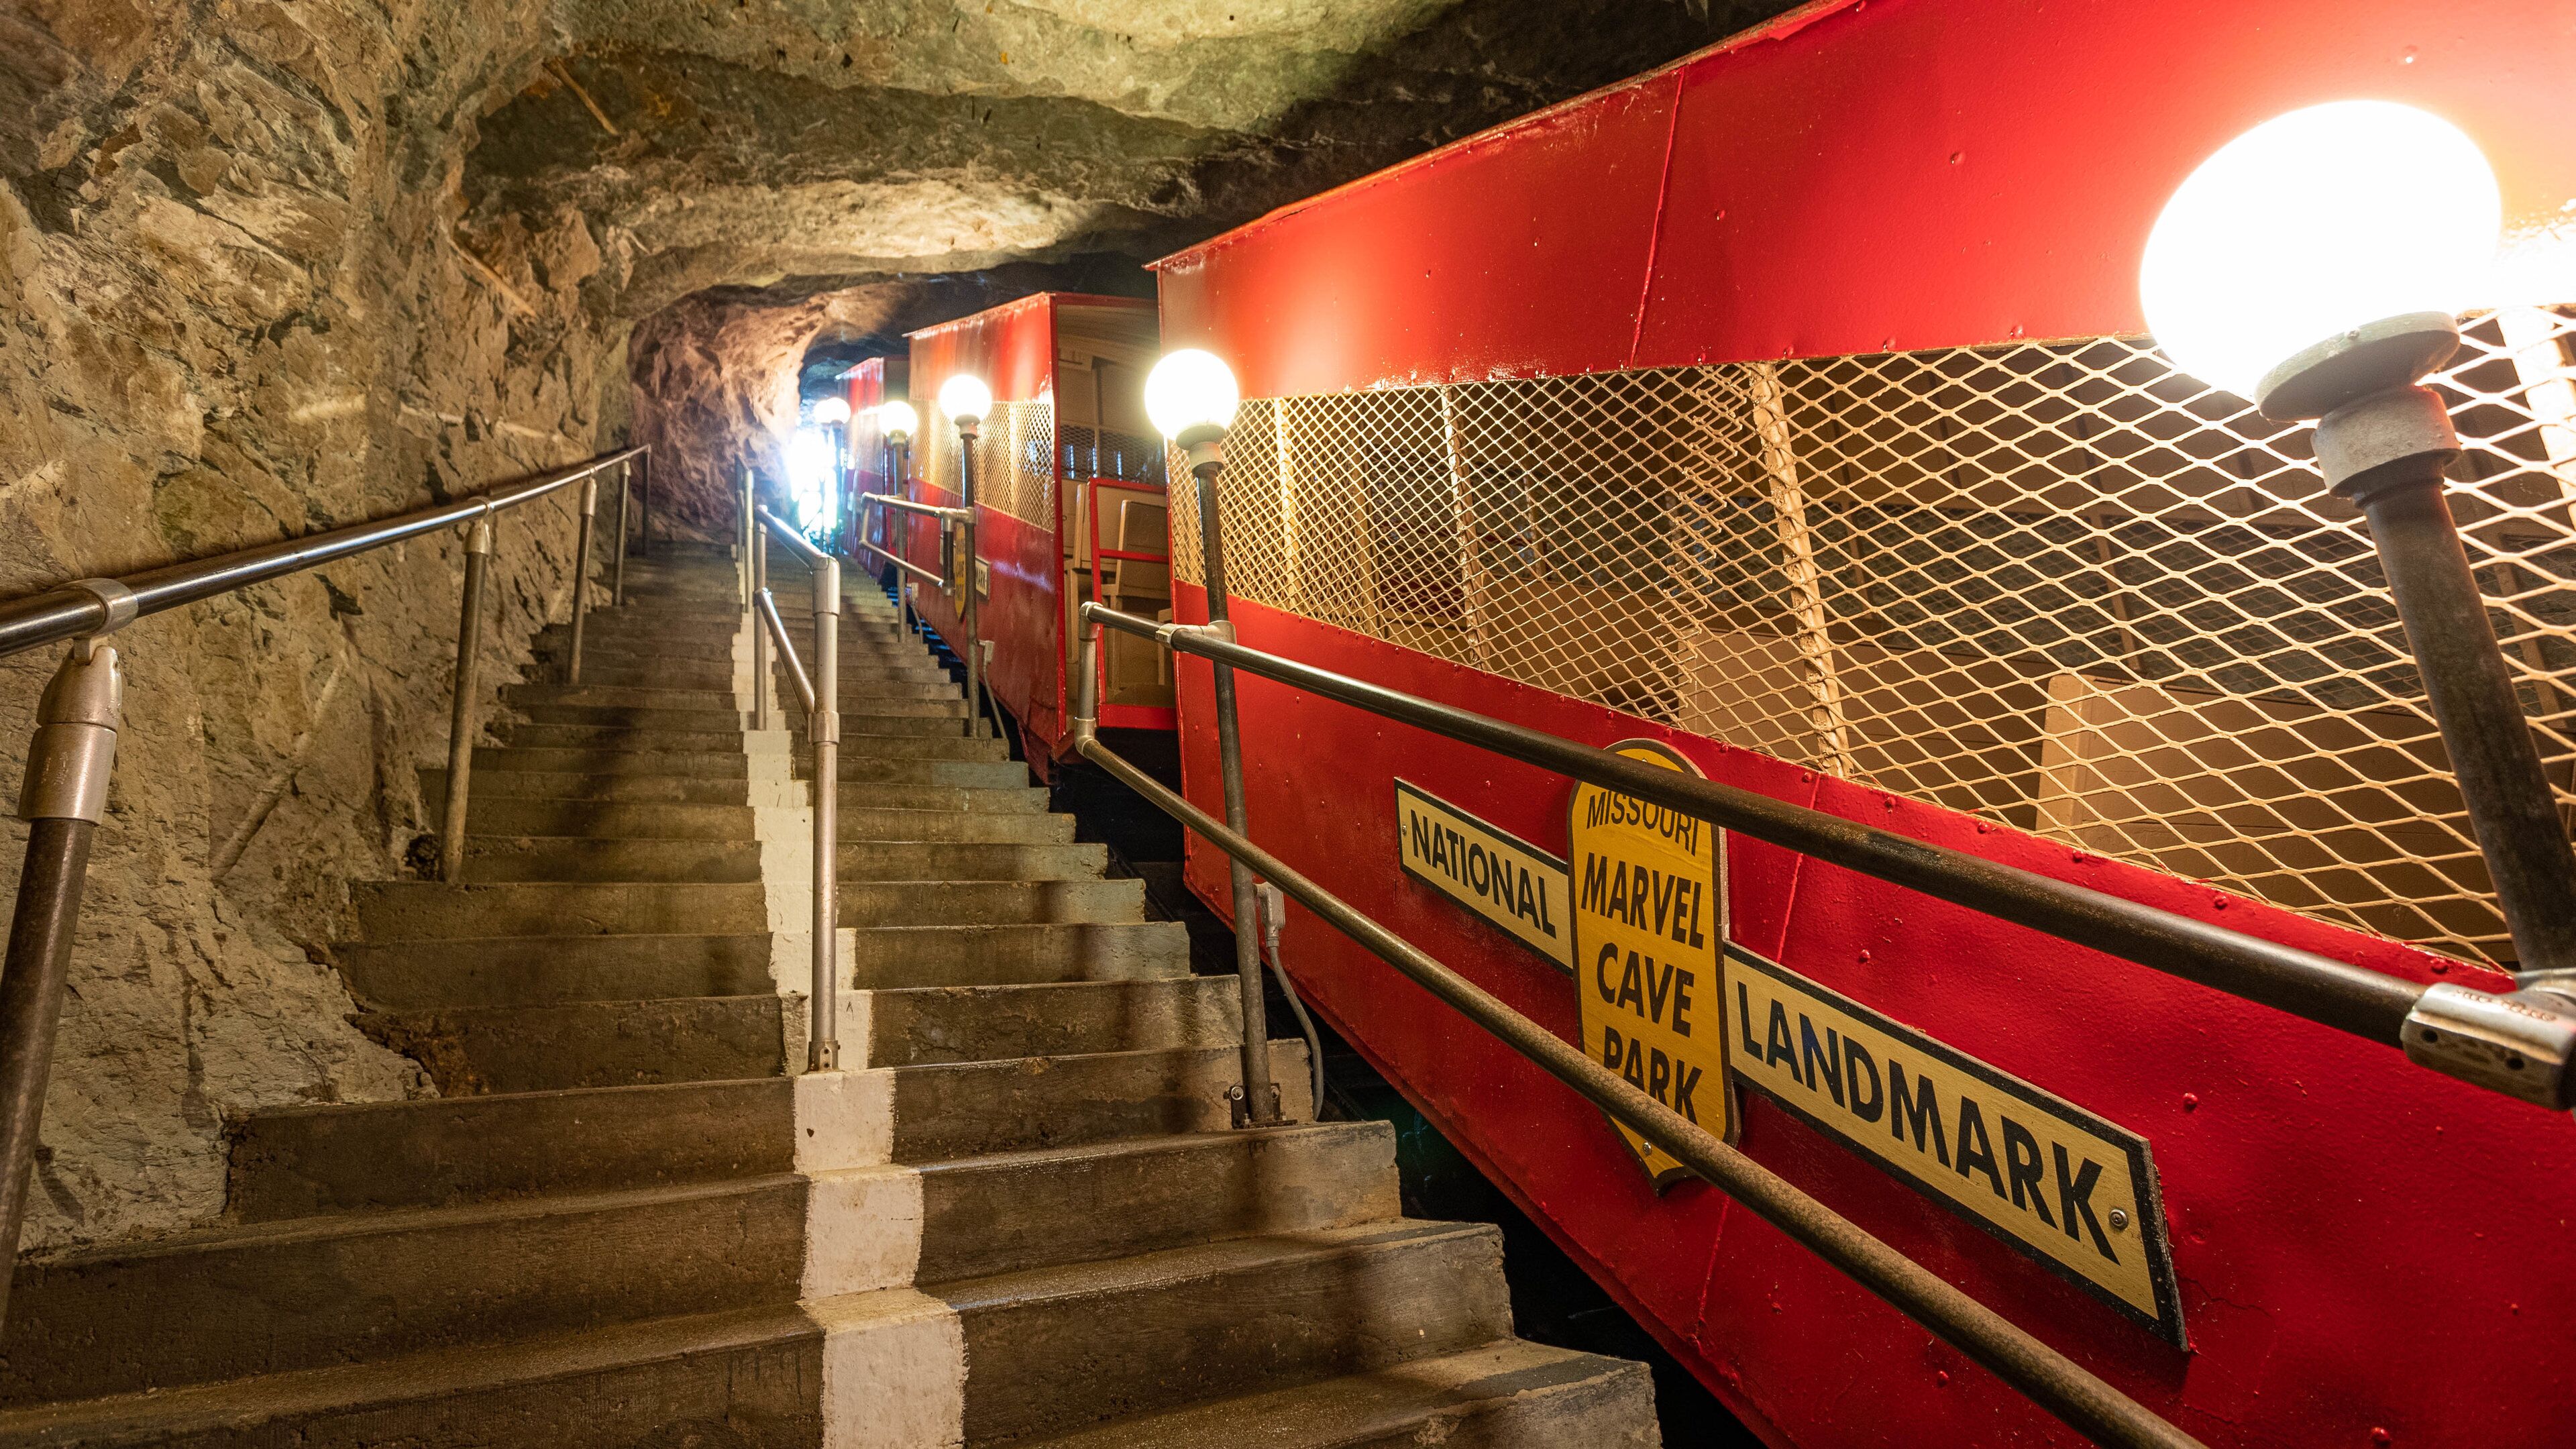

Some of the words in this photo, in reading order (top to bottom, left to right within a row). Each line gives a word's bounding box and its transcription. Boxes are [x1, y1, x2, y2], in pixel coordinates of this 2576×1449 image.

[1587, 791, 1699, 857] MISSOURI
[1410, 810, 1556, 938] NATIONAL
[1581, 852, 1705, 950] MARVEL
[1597, 942, 1695, 1038] CAVE
[1603, 1025, 1703, 1126] PARK
[1736, 981, 2121, 1267] LANDMARK
